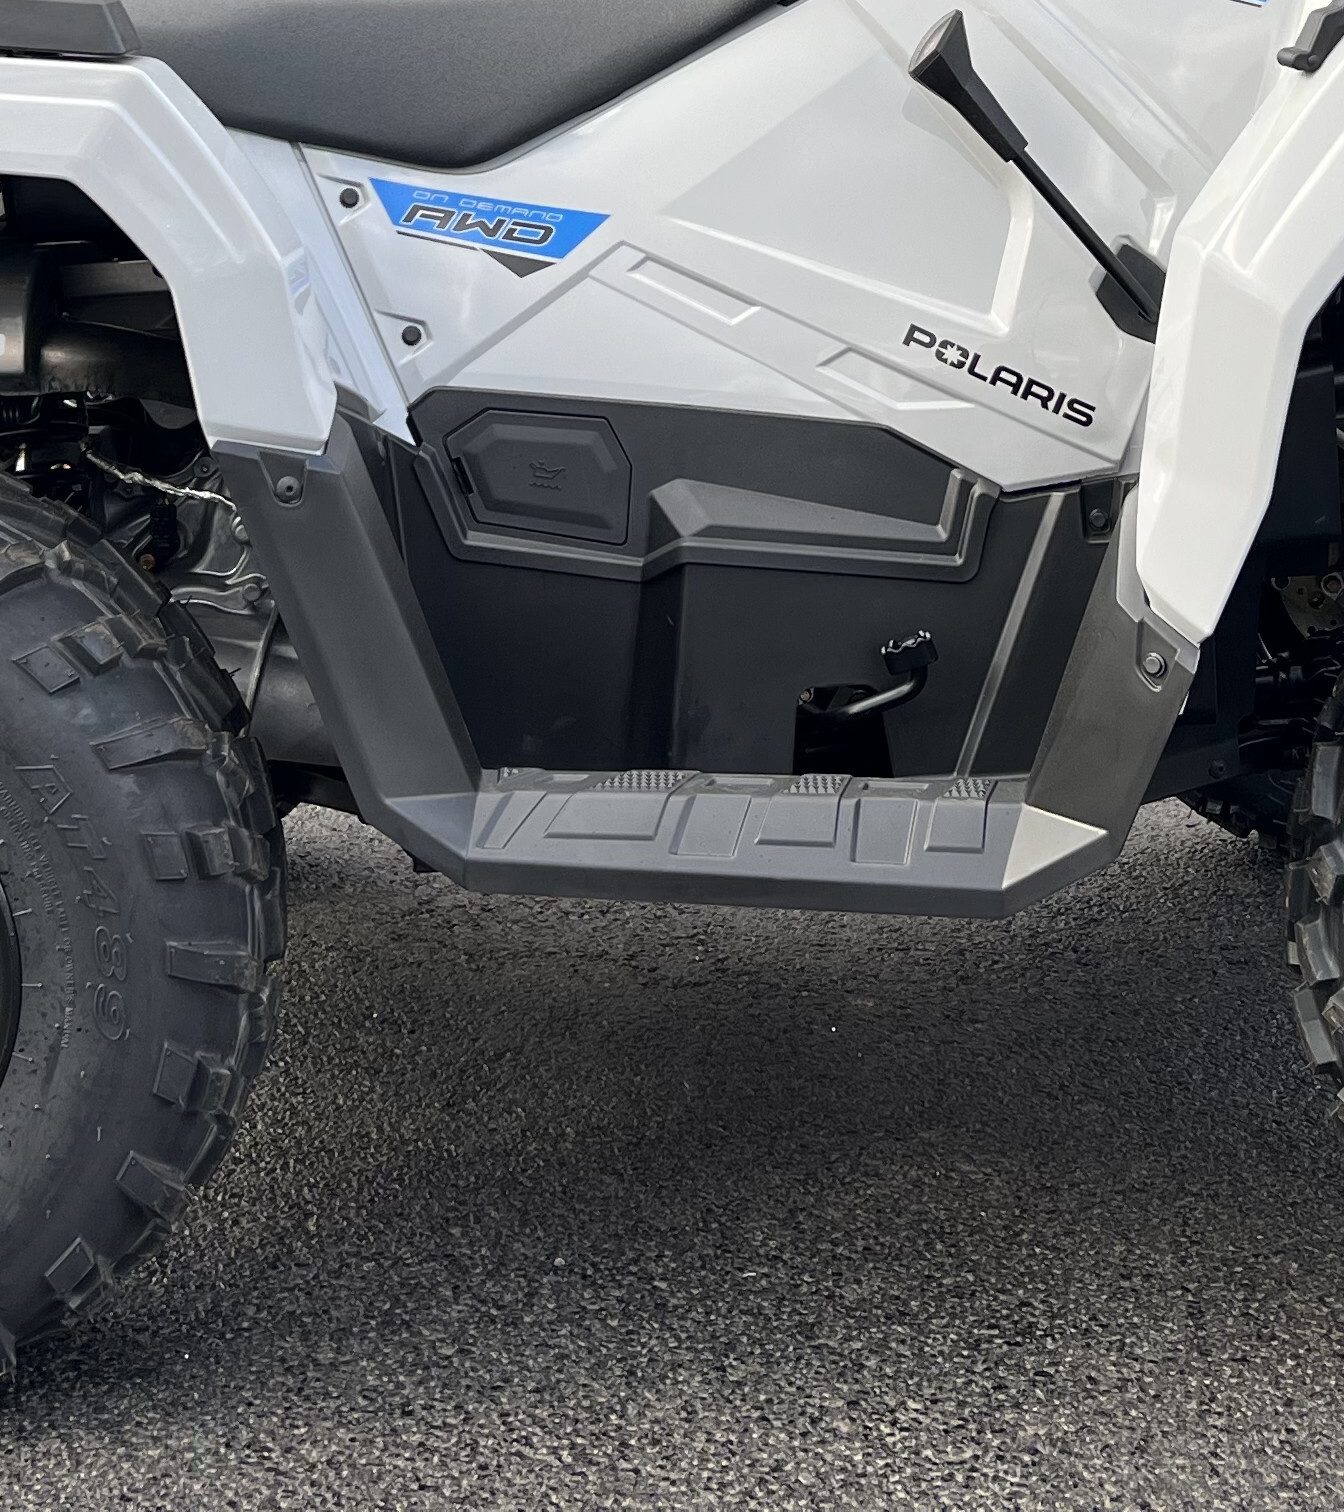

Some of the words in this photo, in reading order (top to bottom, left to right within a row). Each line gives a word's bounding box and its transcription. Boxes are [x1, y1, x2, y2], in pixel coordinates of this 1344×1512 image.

[400, 203, 556, 246] AWD
[412, 189, 449, 204] ON
[458, 197, 565, 223] DEMAND
[901, 323, 1097, 428] POLARIS
